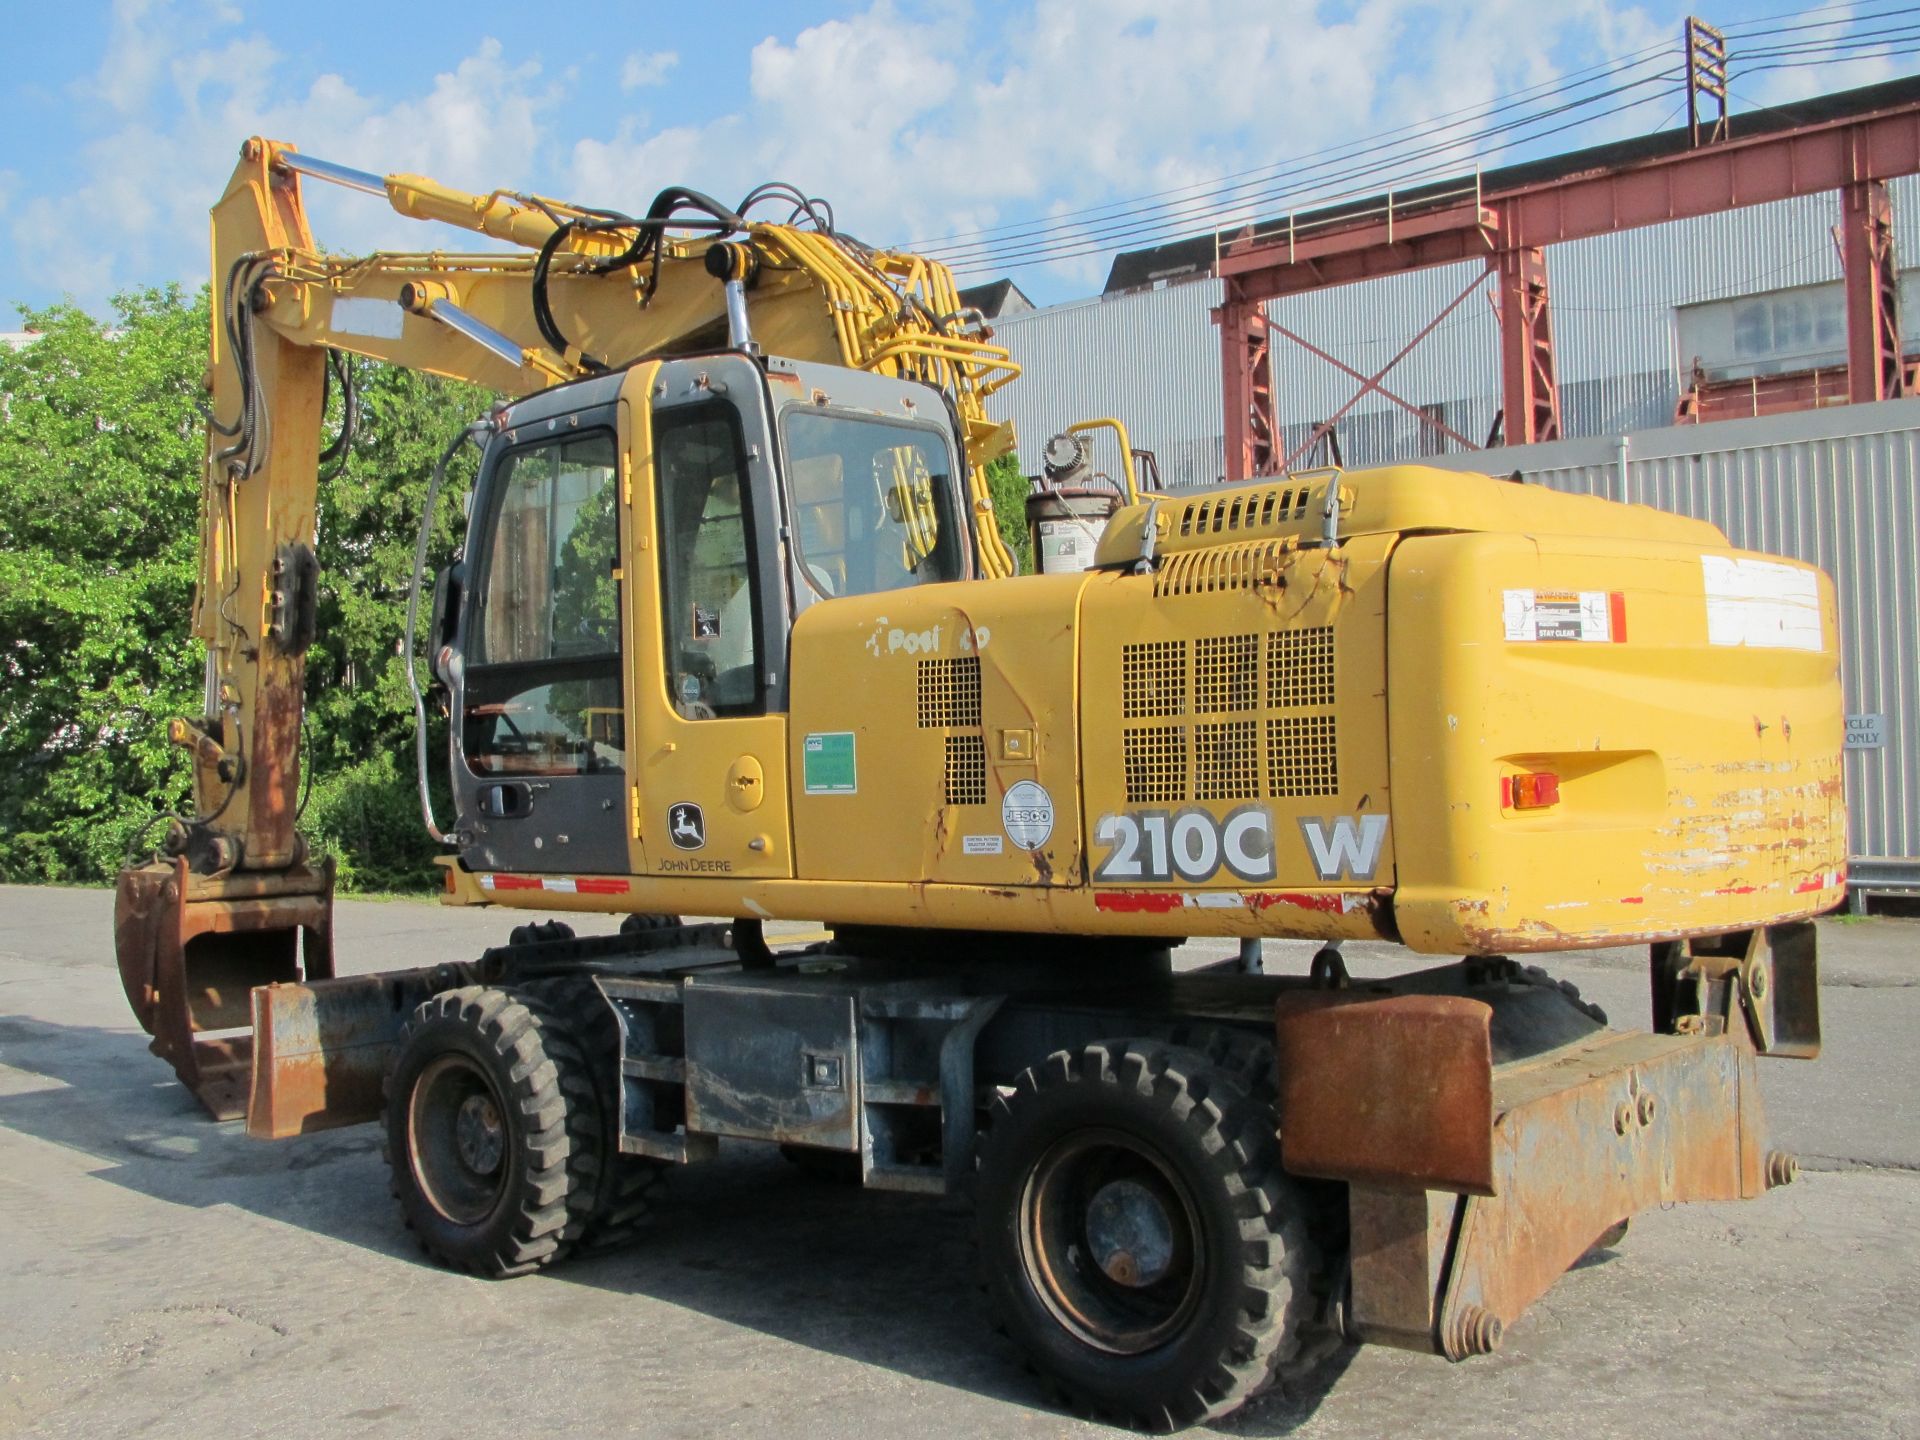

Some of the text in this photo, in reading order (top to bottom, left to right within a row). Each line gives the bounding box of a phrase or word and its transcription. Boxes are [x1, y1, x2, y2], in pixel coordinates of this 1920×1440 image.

[1539, 629, 1575, 637] STAY CLEAR
[1846, 733, 1880, 744] ONLY
[1006, 810, 1050, 823] JESCO
[1093, 805, 1389, 883] 210C W
[658, 858, 732, 872] JOHN DEERE
